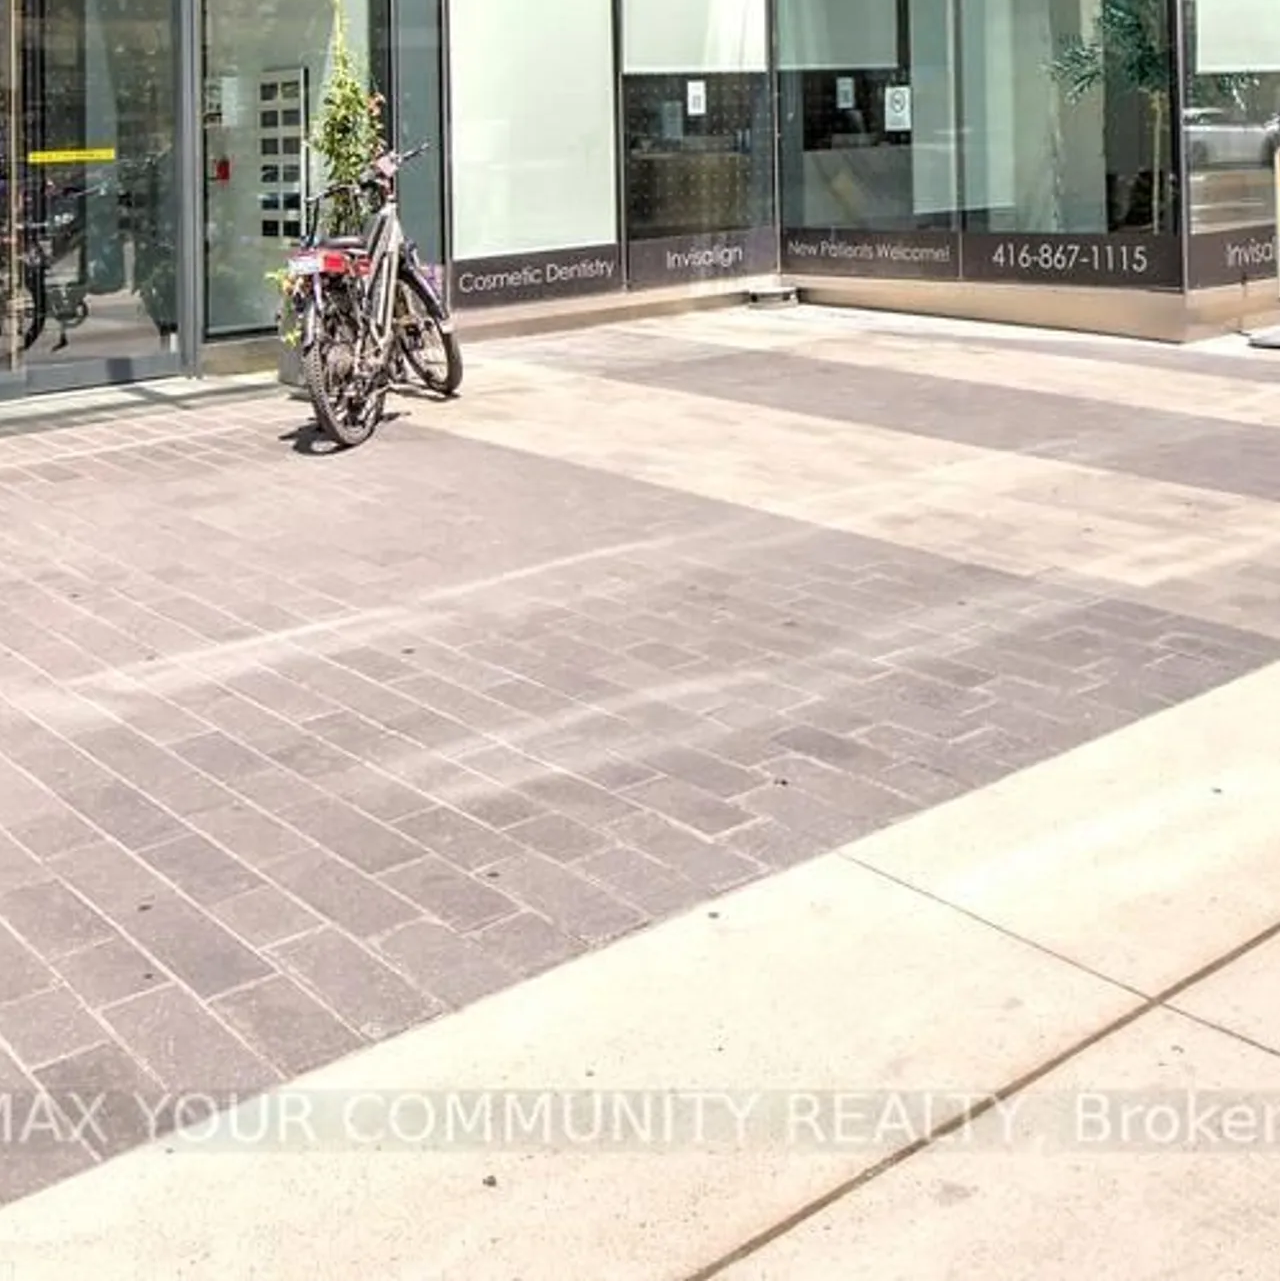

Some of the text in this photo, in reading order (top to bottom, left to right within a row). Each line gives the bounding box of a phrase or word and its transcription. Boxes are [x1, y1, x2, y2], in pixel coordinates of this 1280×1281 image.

[666, 243, 743, 269] Invisalign
[788, 239, 951, 263] New Patients Welcome!
[991, 243, 1148, 273] 416-867-1115
[458, 258, 616, 293] Cosmetic Dentistry
